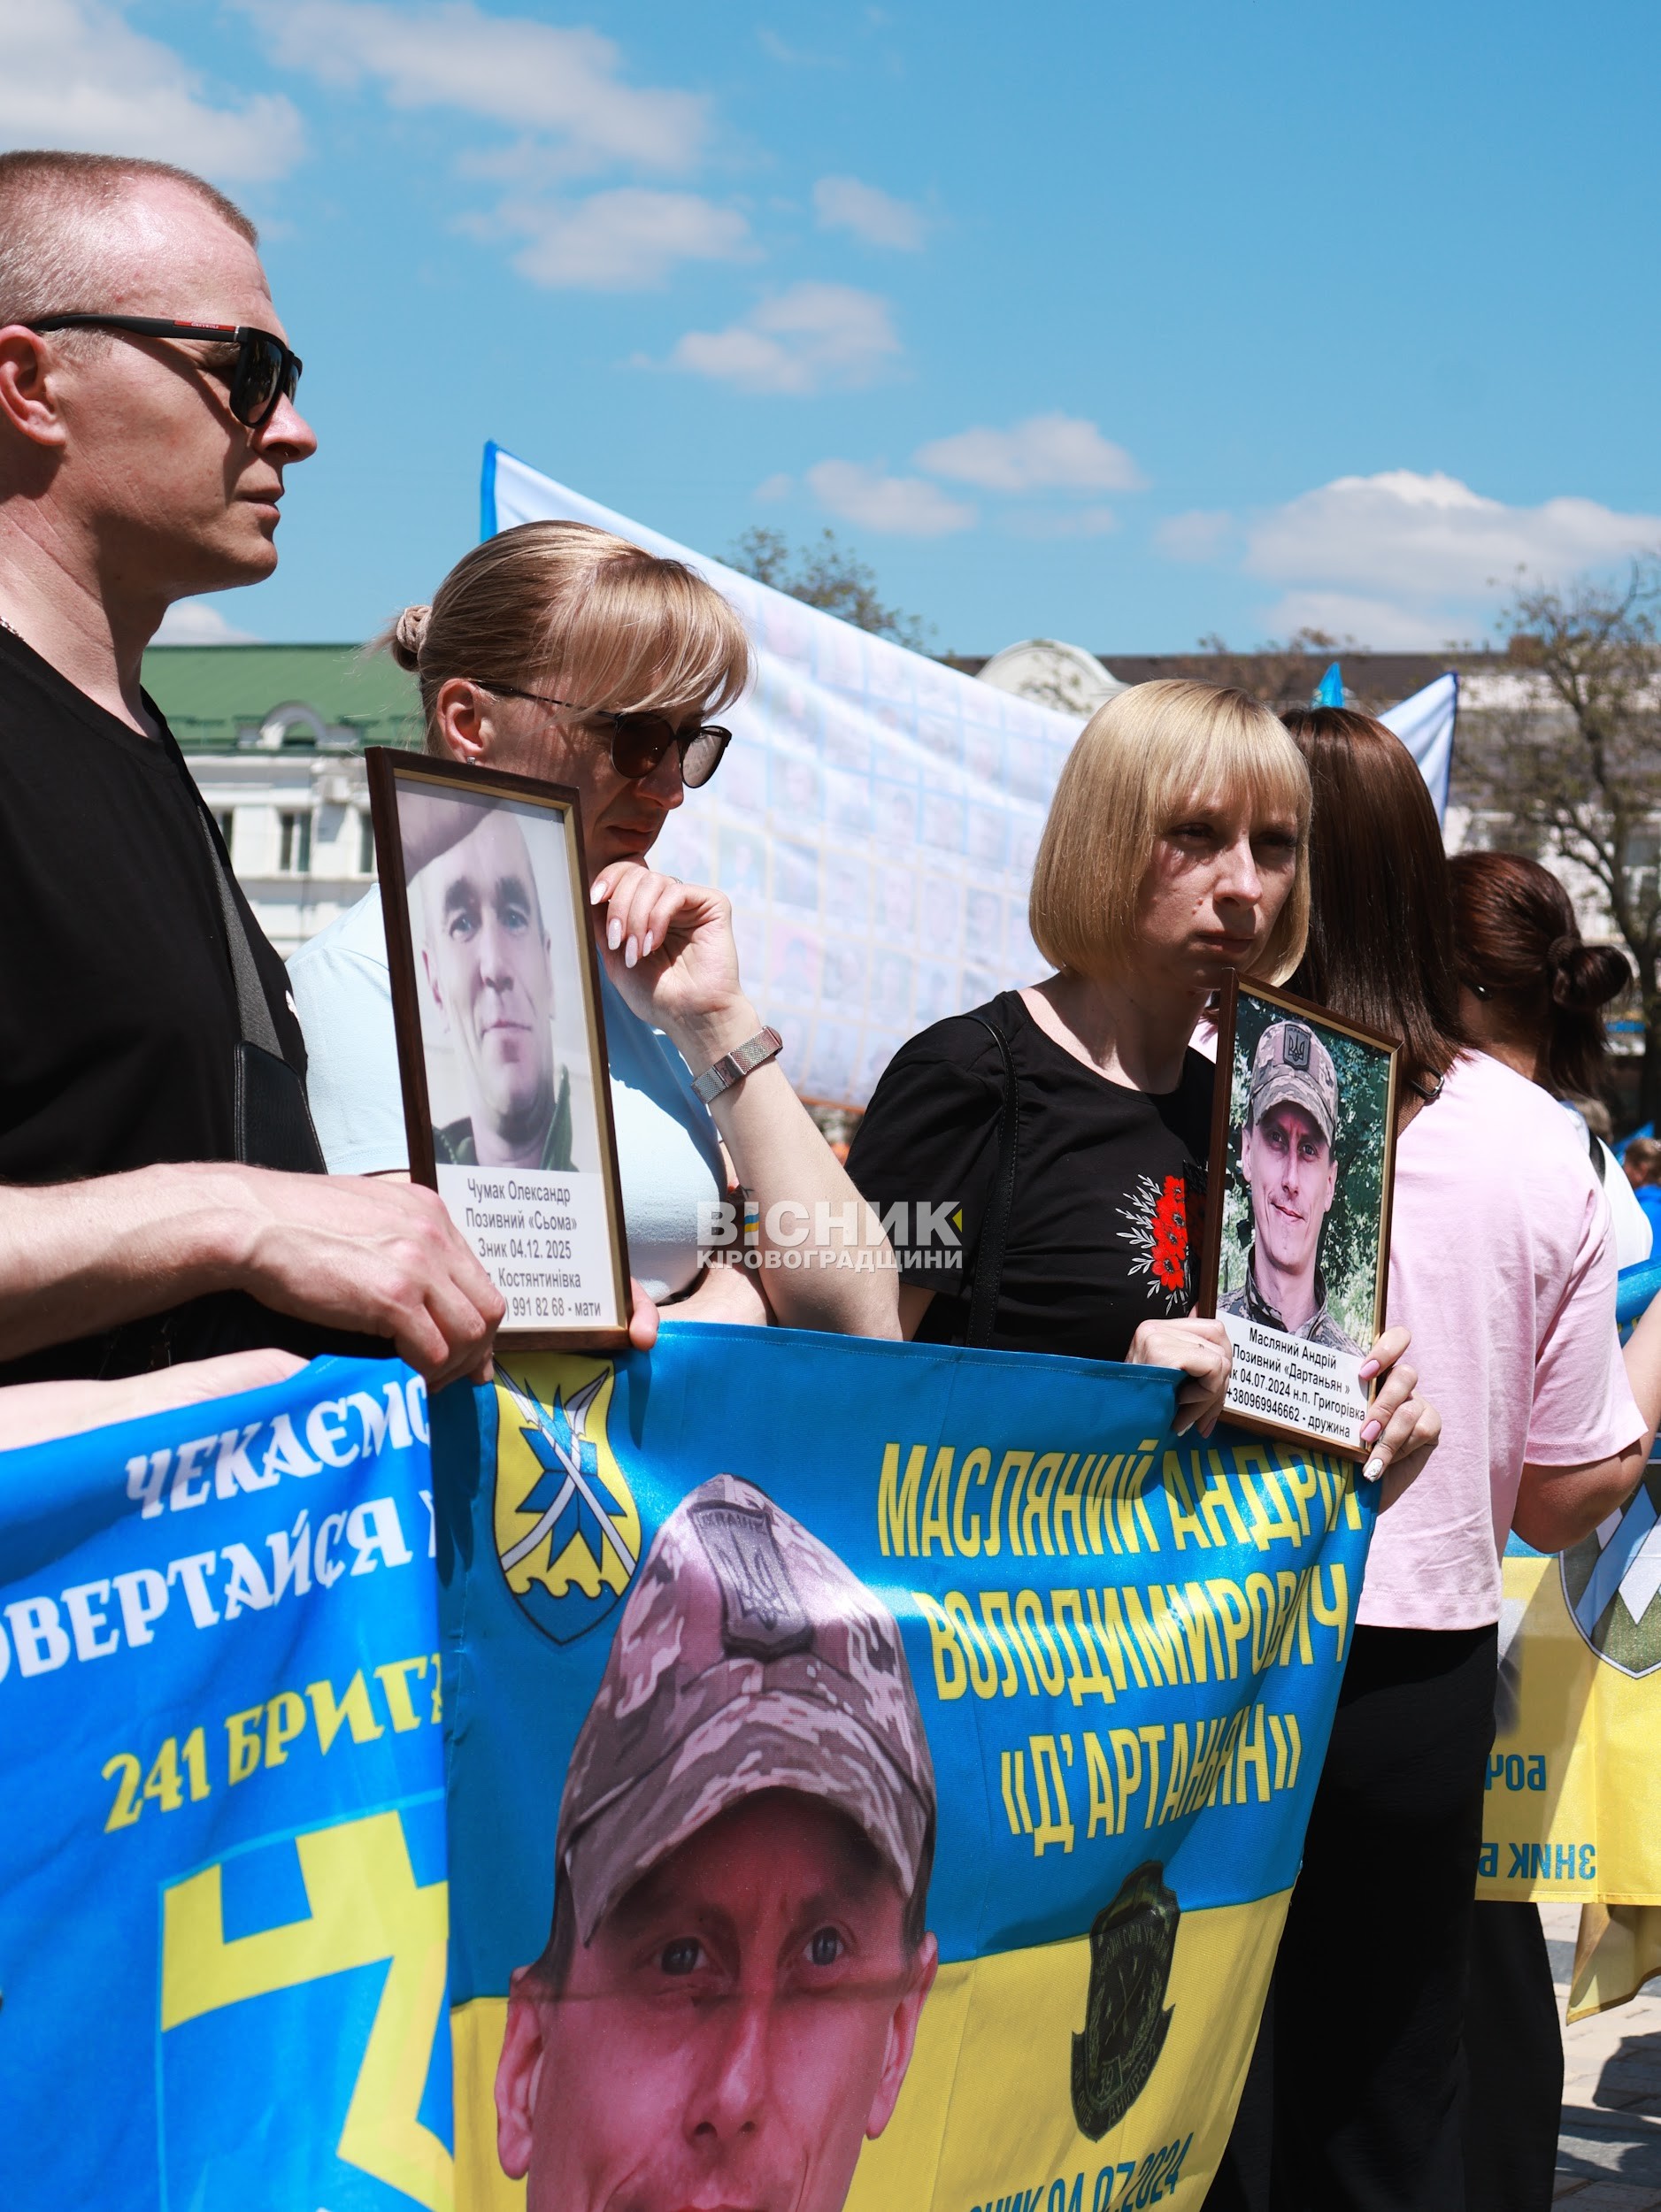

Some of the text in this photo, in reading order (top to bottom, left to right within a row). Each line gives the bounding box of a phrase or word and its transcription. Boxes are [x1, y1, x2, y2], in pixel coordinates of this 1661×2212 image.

[467, 1178, 571, 1206] Чумак Олександр
[465, 1207, 577, 1231] Позивний «Сьома»
[478, 1237, 572, 1259] Зник 04.12. 2025
[498, 1267, 581, 1288] Костянтинівка
[512, 1296, 533, 1317] 991
[535, 1297, 549, 1317] 82
[551, 1297, 565, 1317] 68
[575, 1302, 601, 1317] мати
[1233, 1342, 1281, 1373] Позивний
[1250, 1326, 1337, 1370] Масляний Андрій
[1227, 1387, 1300, 1423] +380969946662
[1308, 1415, 1350, 1439] дружина
[1240, 1368, 1291, 1397] 04.07.2024
[1293, 1388, 1311, 1405] н.п.
[1313, 1393, 1365, 1422] Григорівка
[878, 1440, 1160, 1557] МАСЛЯНИЙ
[911, 1564, 1349, 1706] ВОЛОДИМИРОВИЧ
[102, 1726, 211, 1834] 241
[1048, 2131, 1194, 2212] 0407.2024
